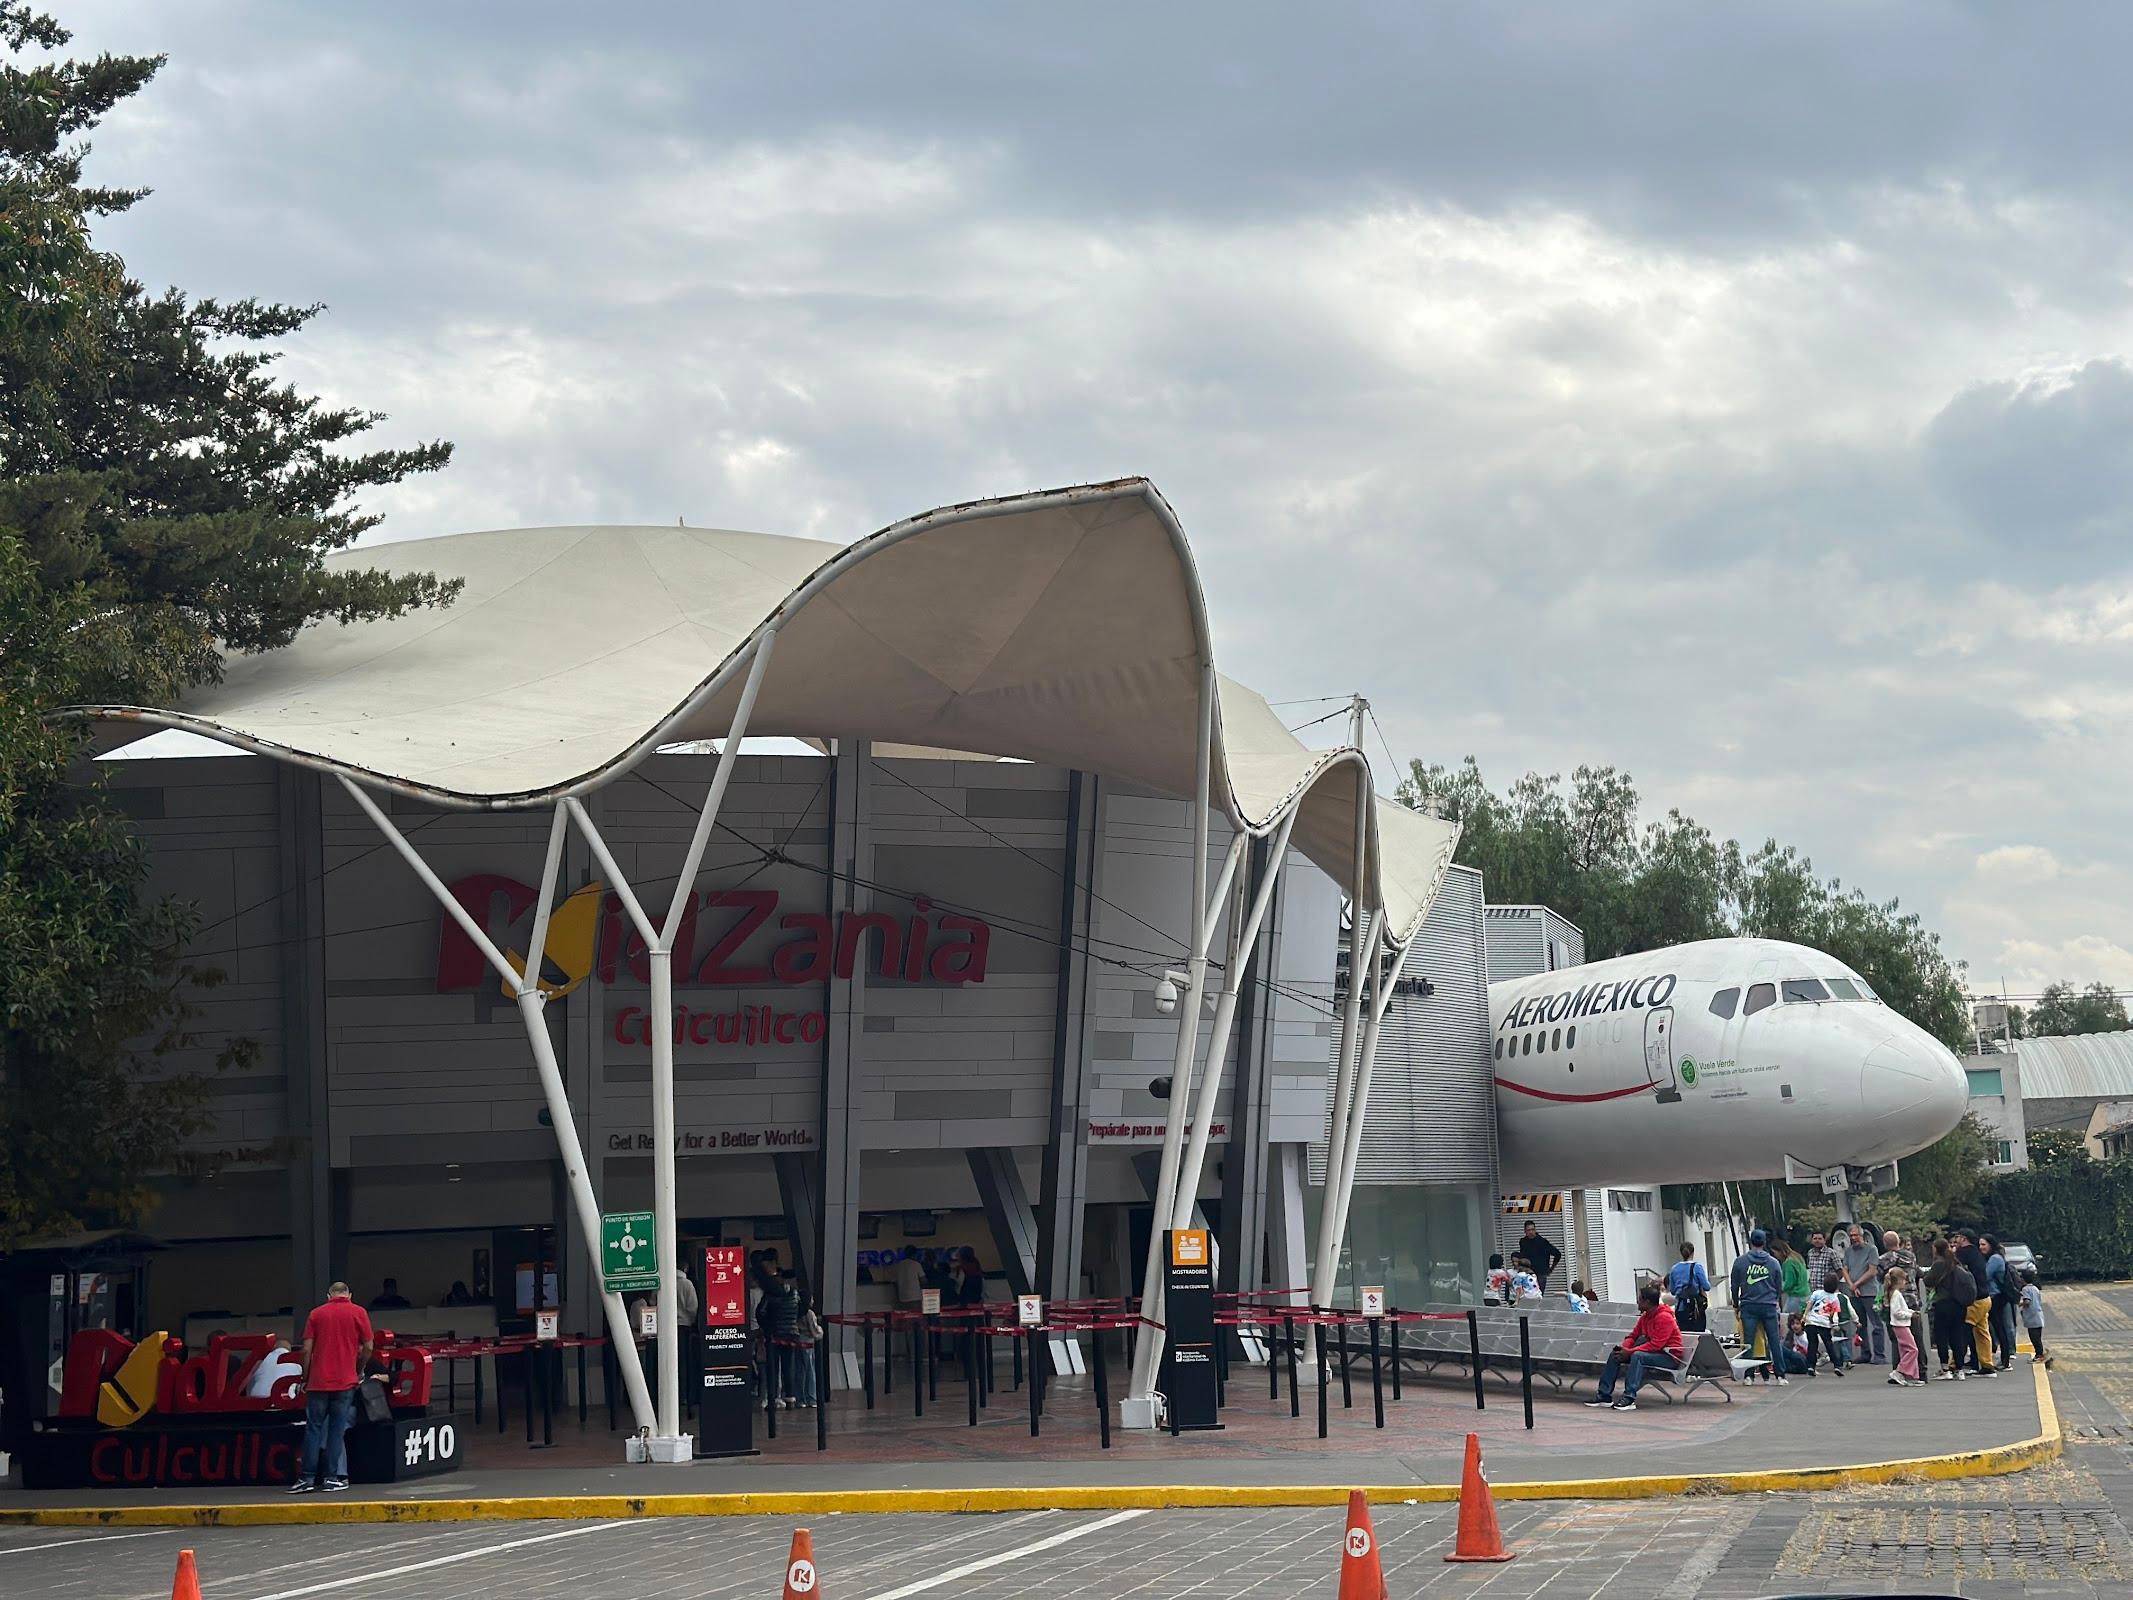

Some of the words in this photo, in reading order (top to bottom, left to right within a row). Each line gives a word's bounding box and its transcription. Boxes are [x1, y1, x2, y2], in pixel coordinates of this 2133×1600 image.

[1499, 973, 1677, 1031] AEROMEXICO
[1717, 1059, 1736, 1068] Verde
[1132, 1125, 1152, 1139] para
[609, 1134, 632, 1151] Get
[638, 1134, 680, 1153] Rey
[685, 1132, 704, 1149] for
[708, 1134, 716, 1148] a
[721, 1131, 761, 1148] Better
[1825, 1173, 1842, 1187] MEX
[626, 1239, 630, 1248] 1
[705, 1333, 746, 1341] PREFERENCIAL
[60, 1328, 433, 1427] KidZaia
[405, 1424, 455, 1466] #10
